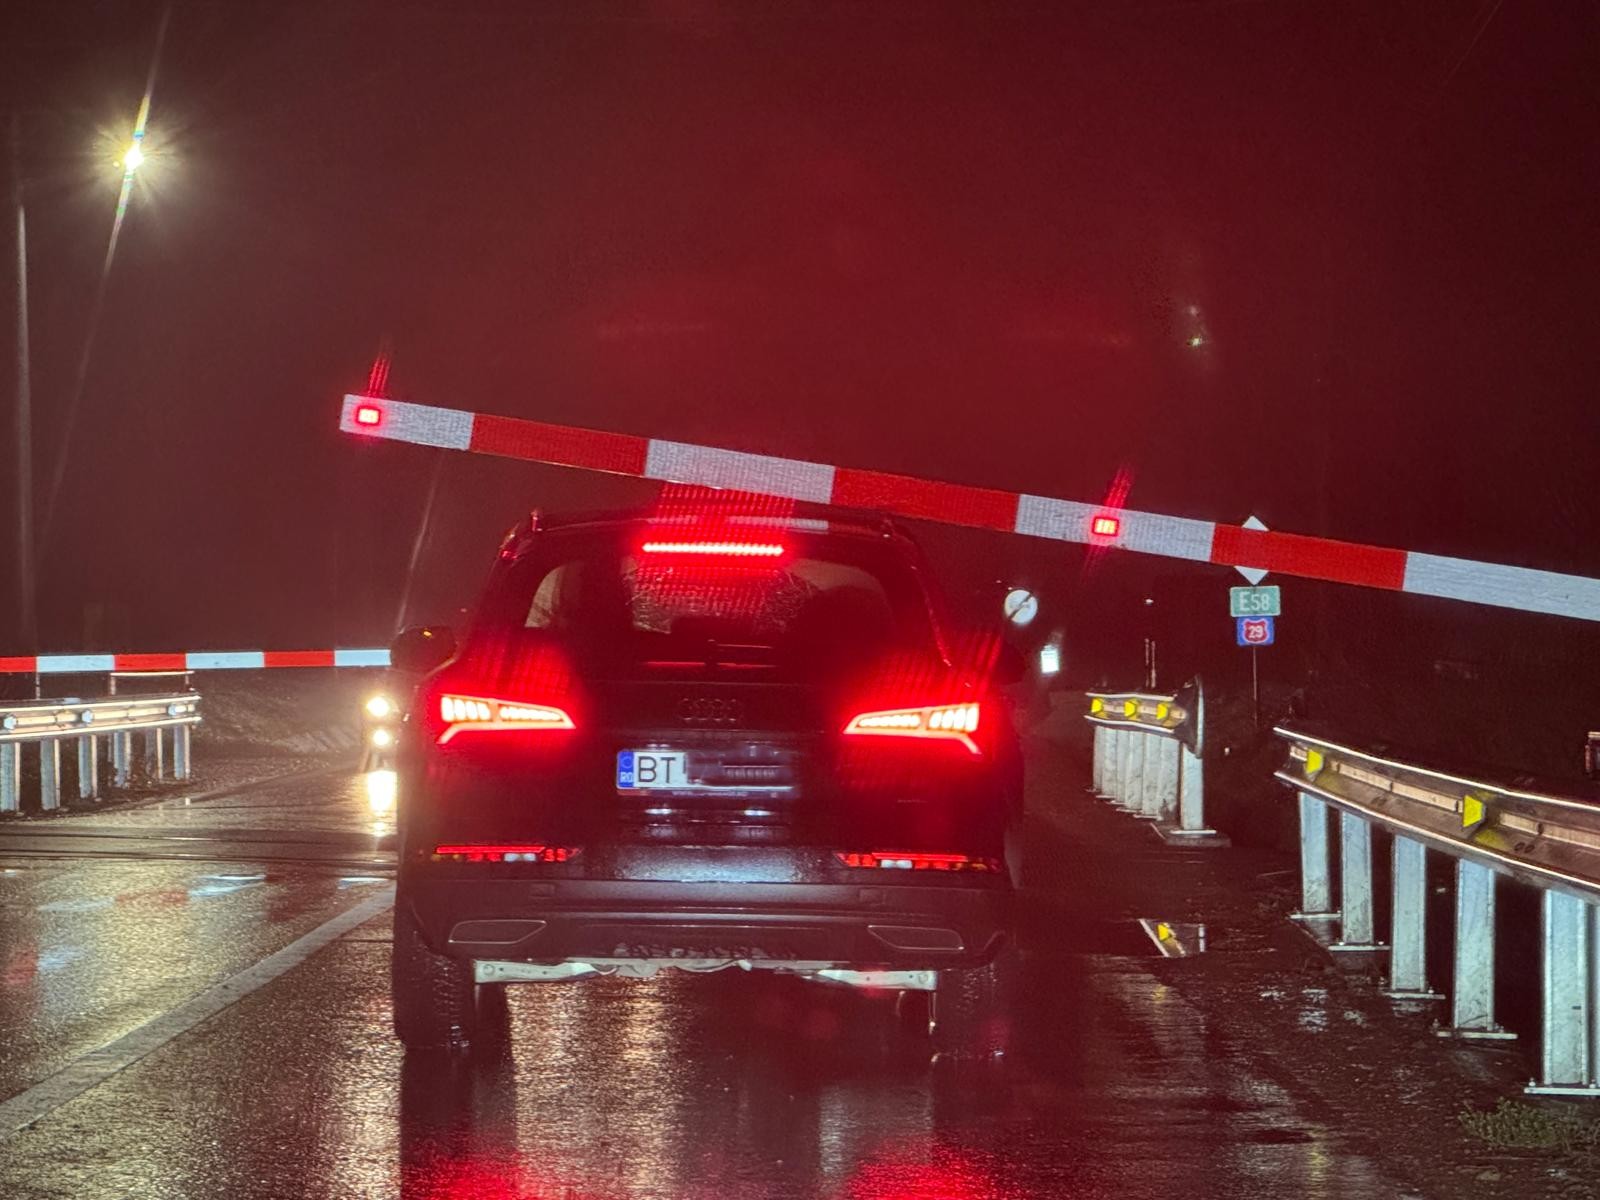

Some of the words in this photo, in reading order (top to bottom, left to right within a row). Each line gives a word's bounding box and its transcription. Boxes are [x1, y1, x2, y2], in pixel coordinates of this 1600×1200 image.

[1240, 591, 1270, 611] E58
[1248, 625, 1264, 639] 29
[620, 771, 633, 783] RO
[637, 755, 677, 784] BT
